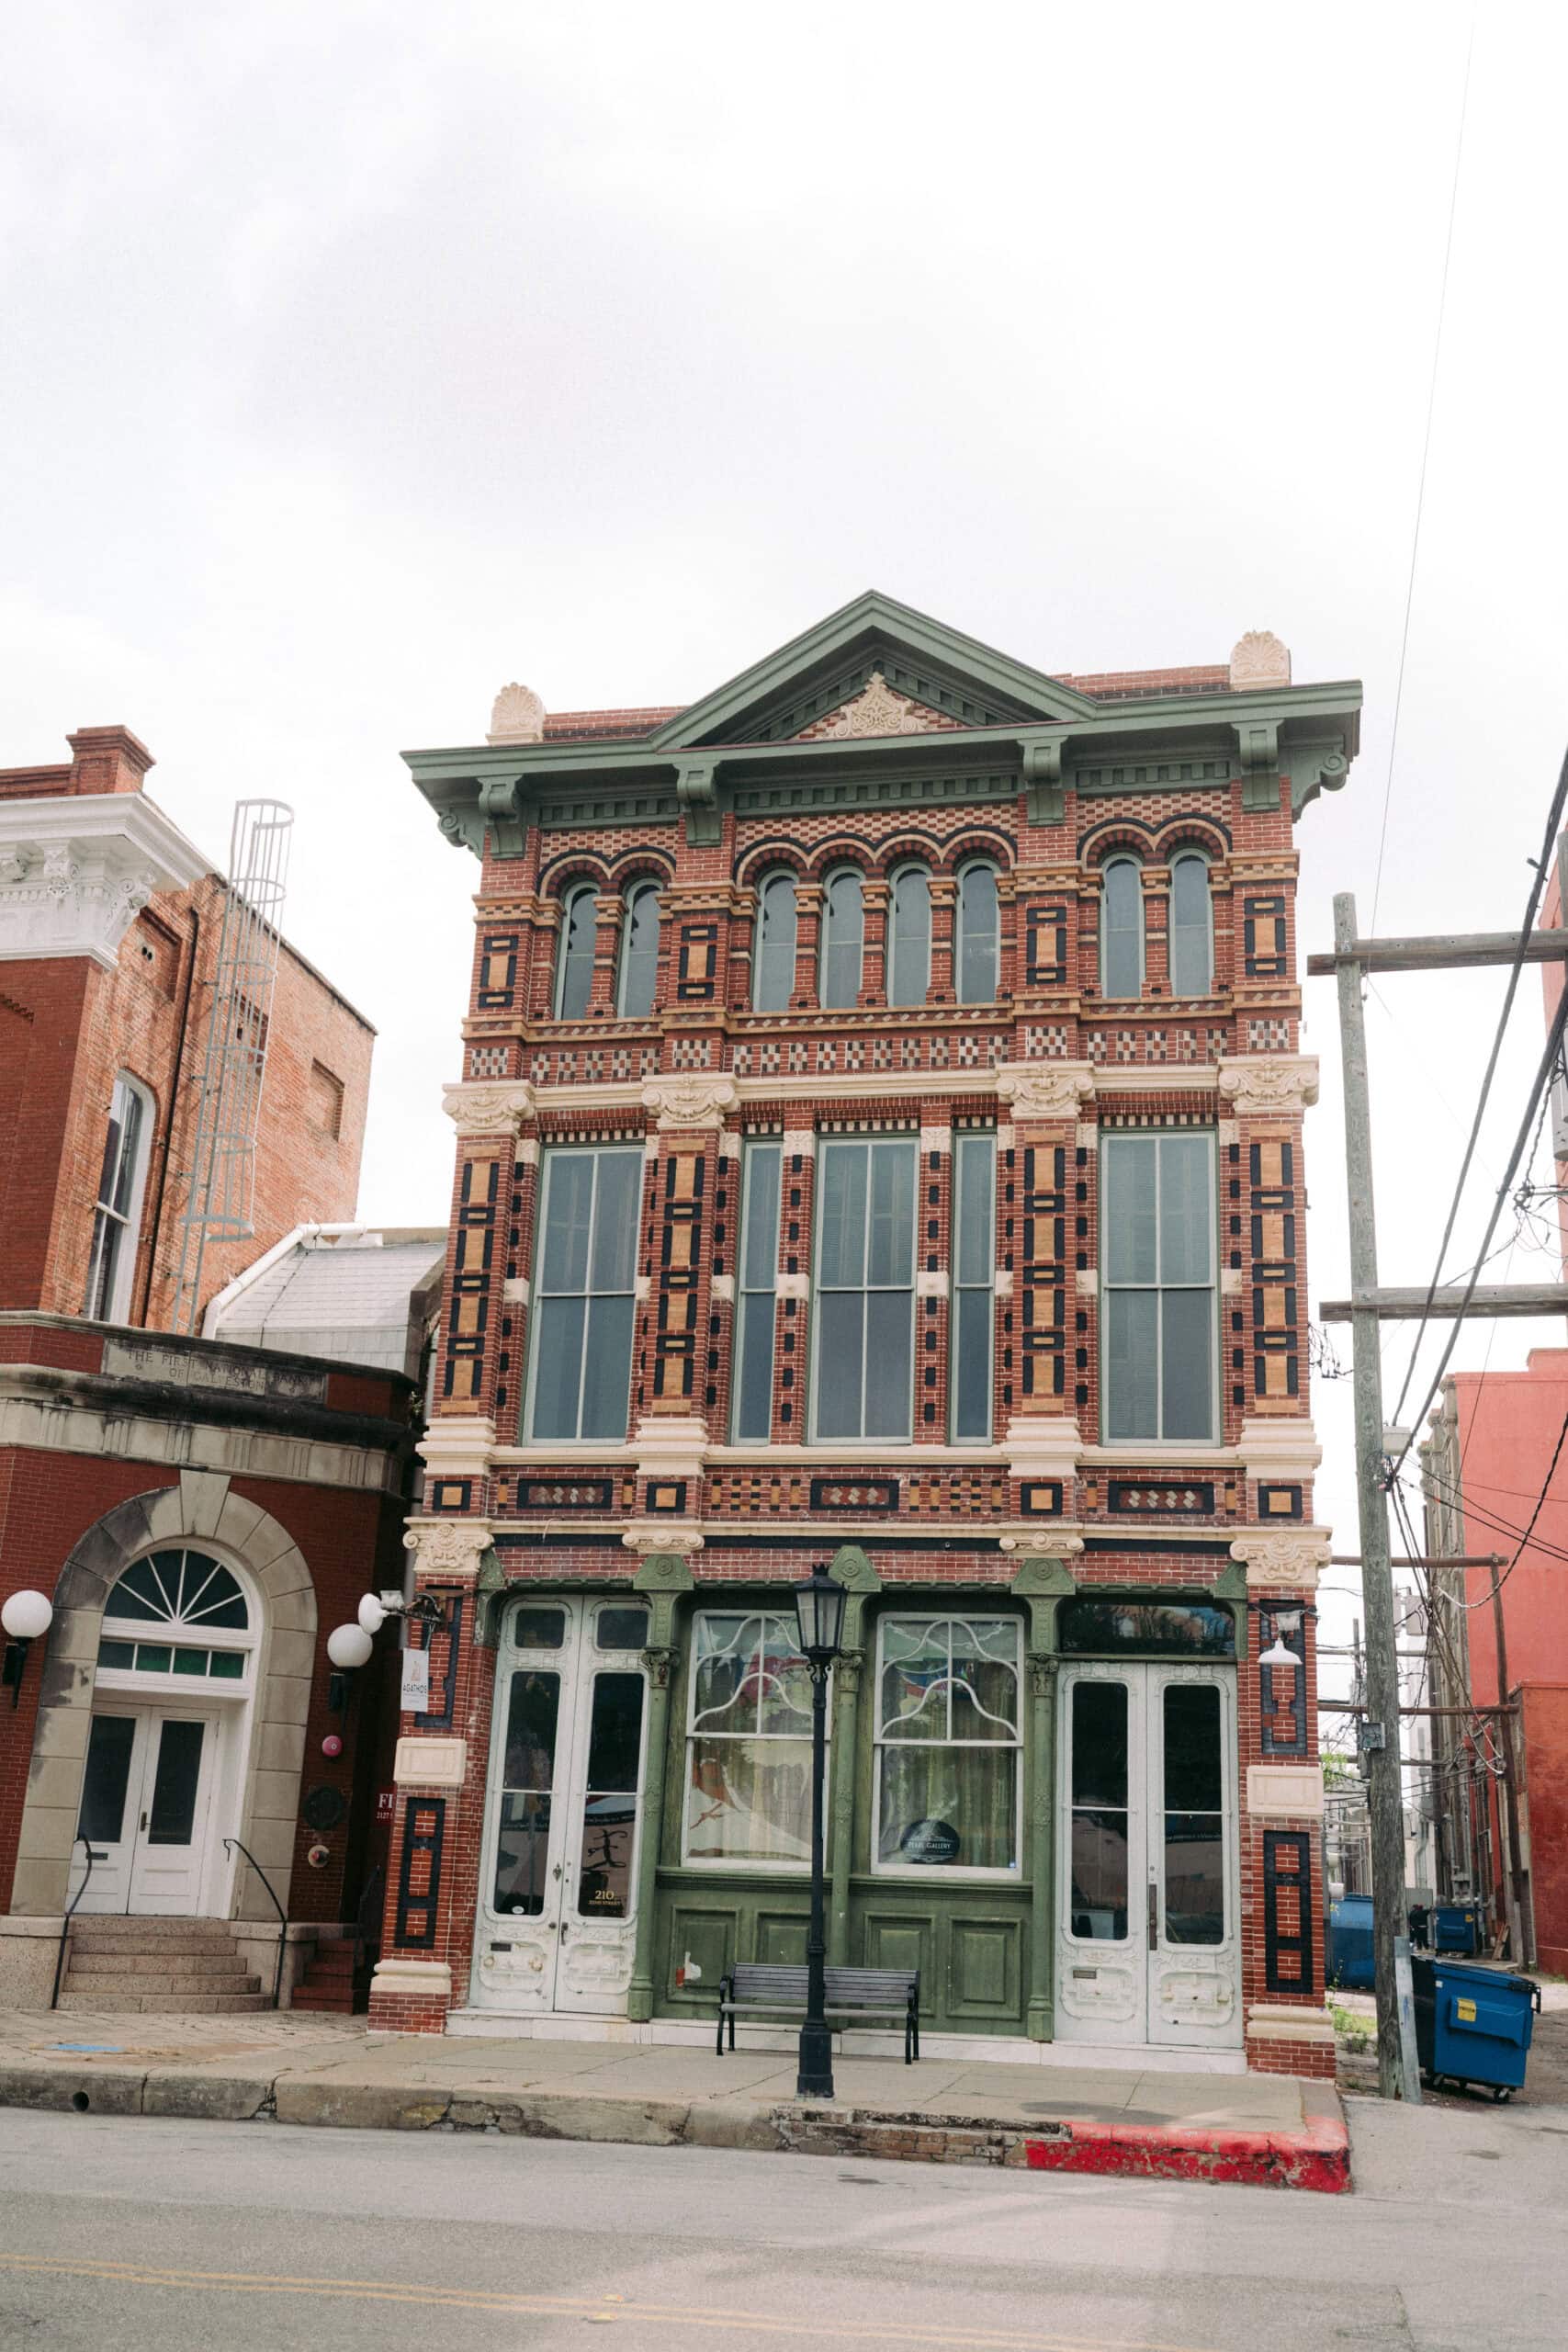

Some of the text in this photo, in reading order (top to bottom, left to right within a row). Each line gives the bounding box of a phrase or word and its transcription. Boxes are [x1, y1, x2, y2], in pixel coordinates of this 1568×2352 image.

[128, 1349, 154, 1363] THE
[162, 1354, 198, 1369] FIRST
[206, 1360, 265, 1379] NATIONAL
[169, 1368, 185, 1379] OF
[594, 1890, 615, 1900] 210
